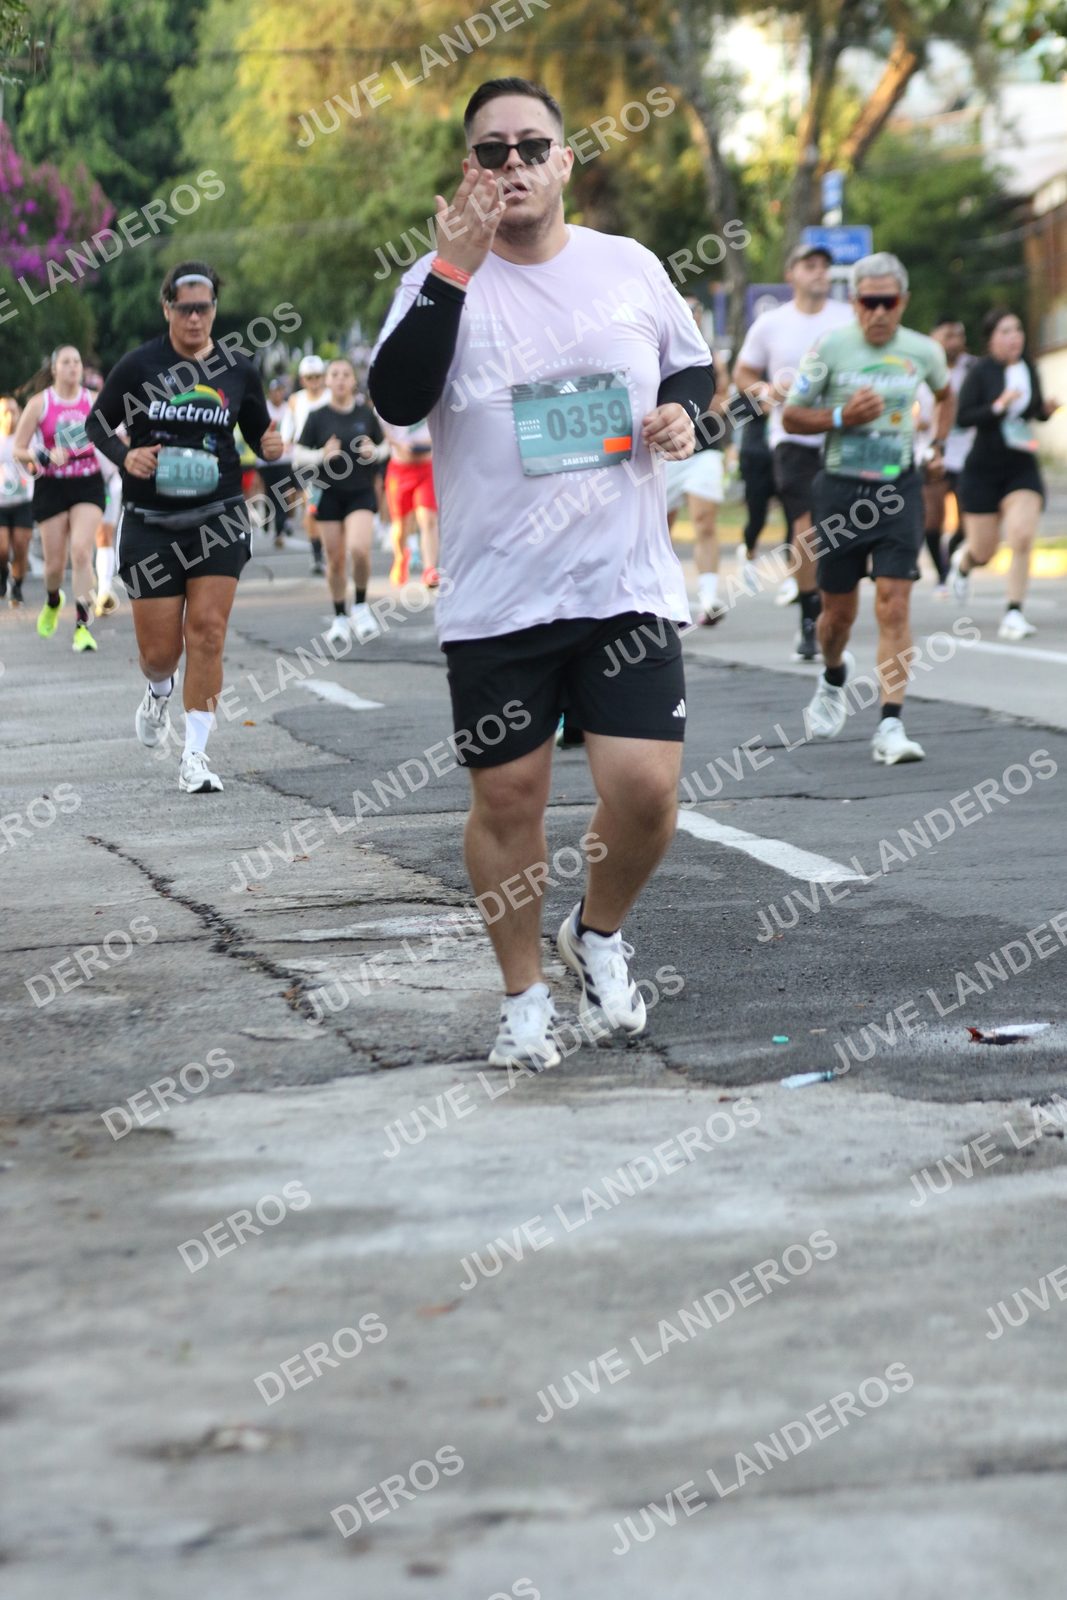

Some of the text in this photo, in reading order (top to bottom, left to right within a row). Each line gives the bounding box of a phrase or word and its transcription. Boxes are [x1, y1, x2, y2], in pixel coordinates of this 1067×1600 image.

[148, 400, 230, 426] Electrolit
[547, 400, 628, 442] 0359
[562, 455, 600, 466] SAMSUNG
